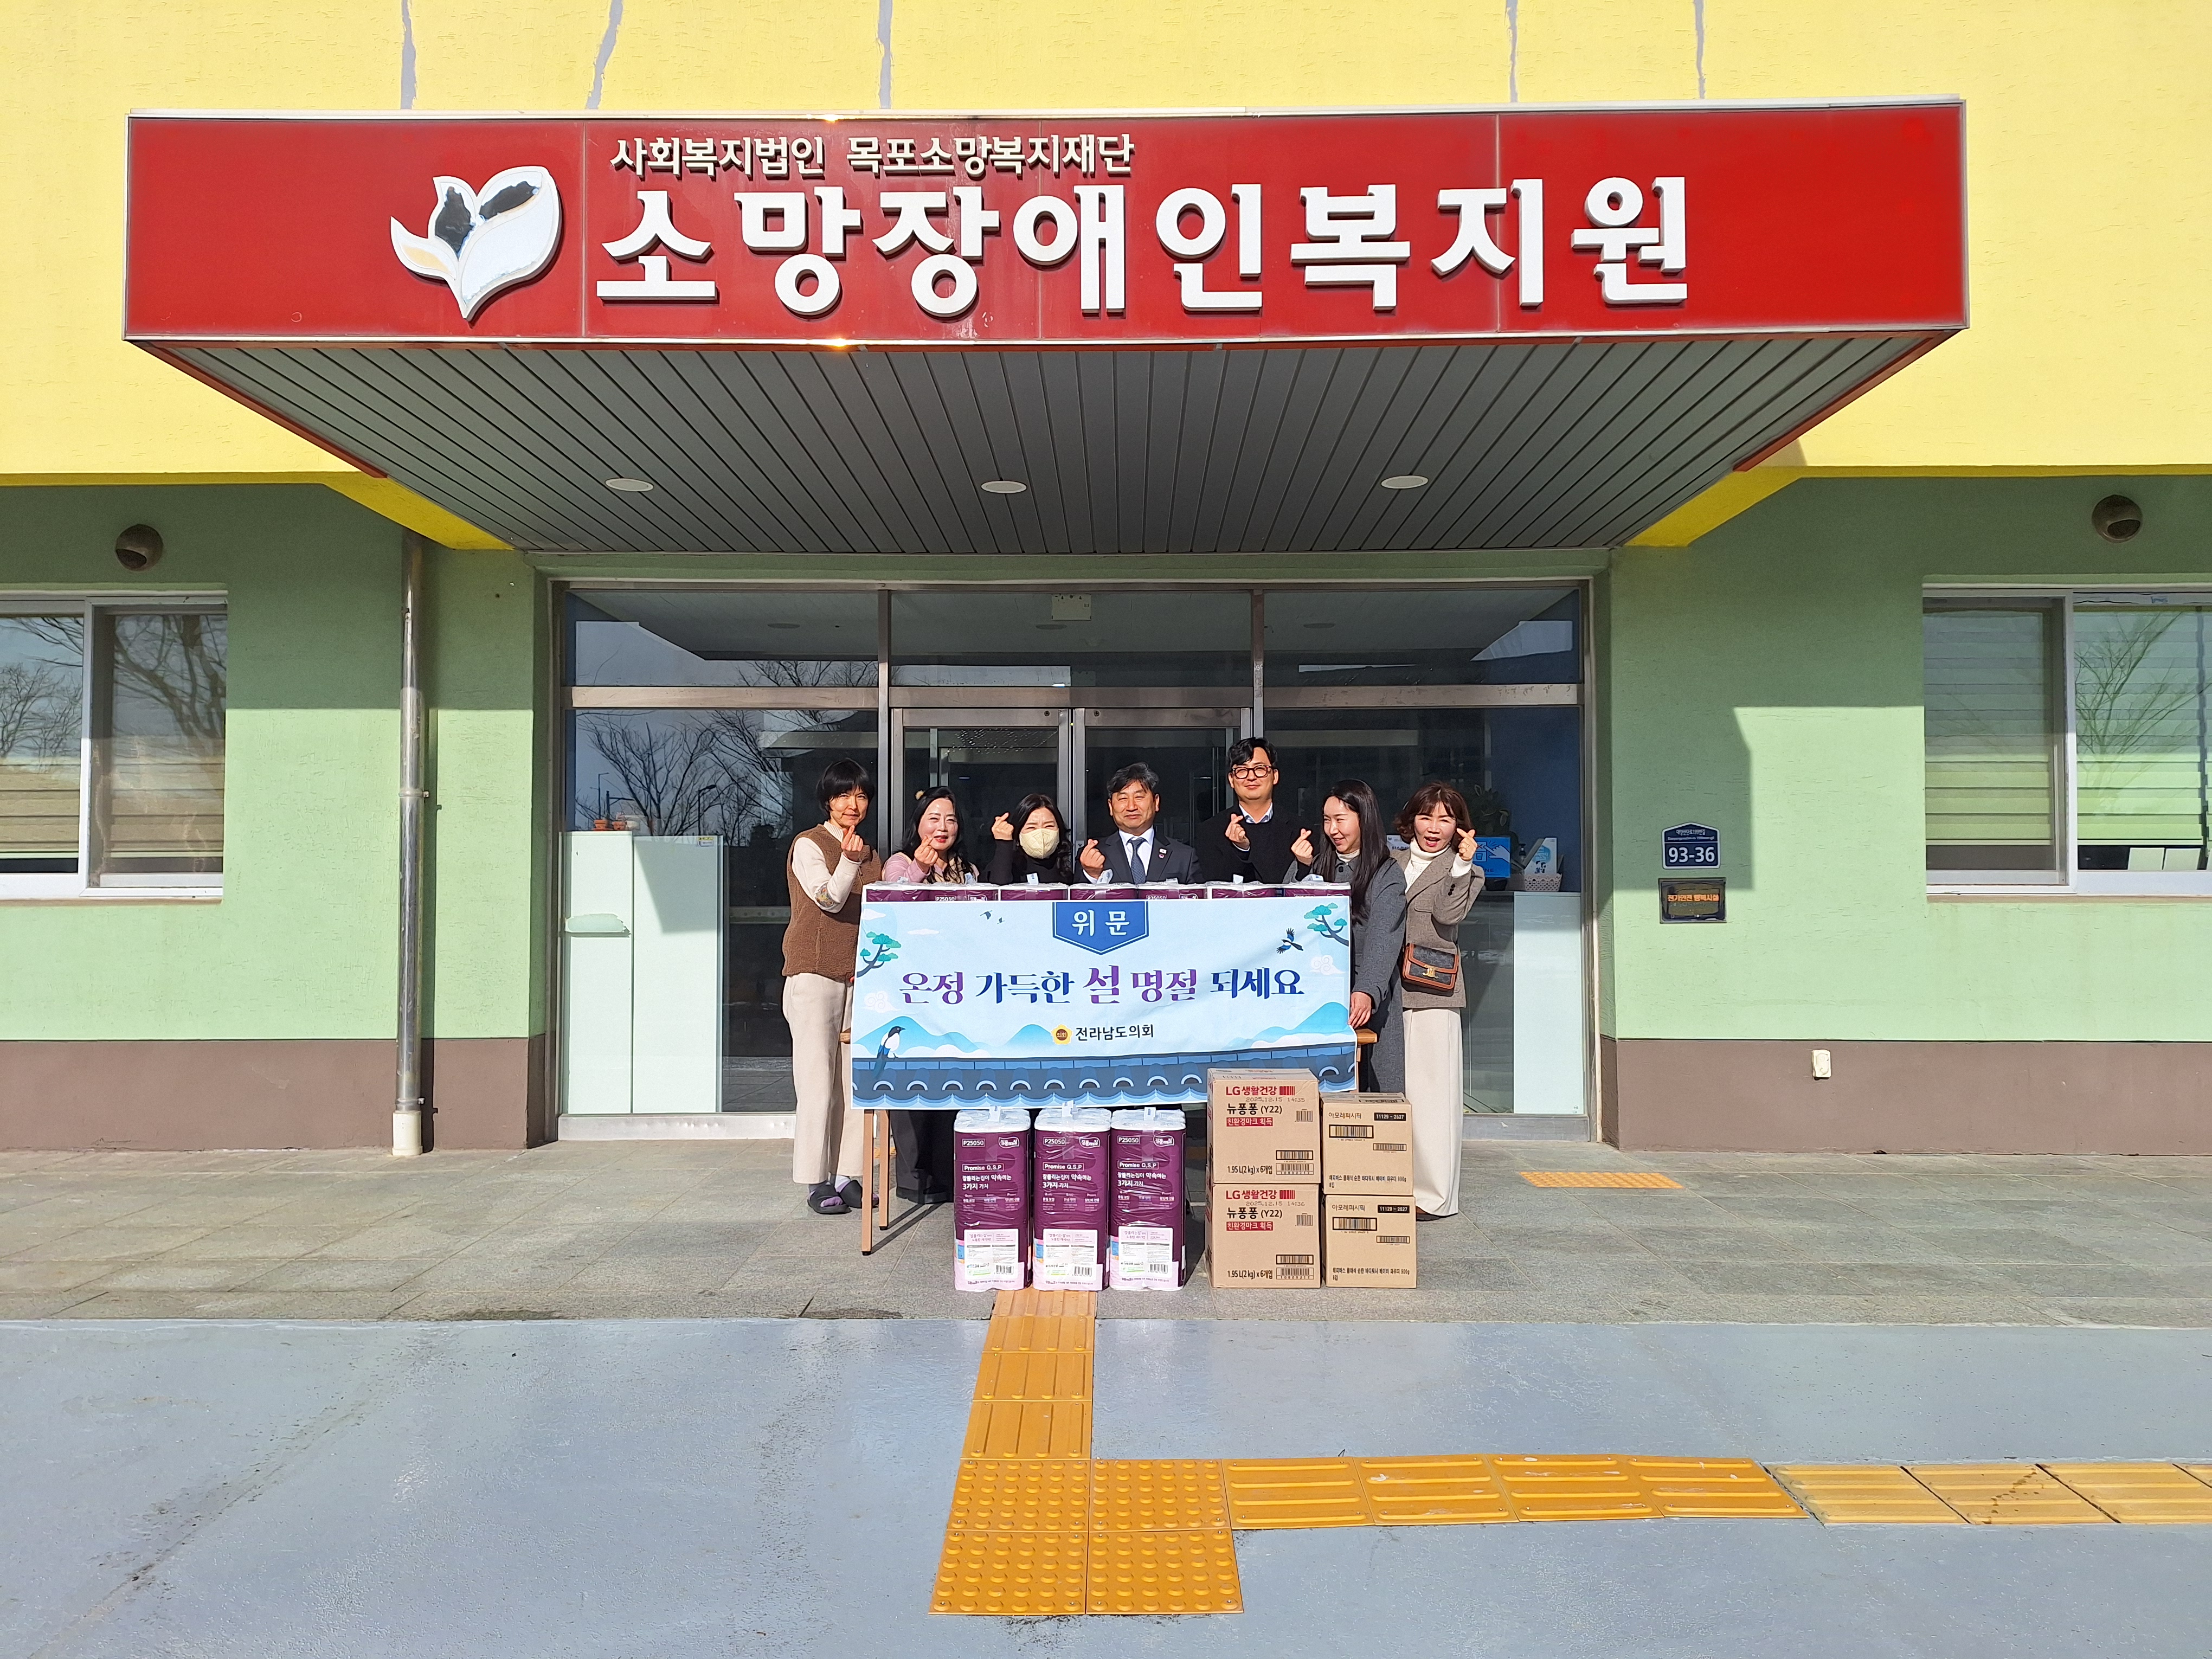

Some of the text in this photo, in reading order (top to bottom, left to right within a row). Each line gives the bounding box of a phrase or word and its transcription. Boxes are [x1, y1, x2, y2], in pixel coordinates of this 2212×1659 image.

[611, 133, 1135, 176] 사회복지법인 목포소망복지재단
[596, 176, 1687, 316] 소망장애인복지원
[1668, 847, 1715, 863] 93-36
[899, 965, 1304, 1004] 온정 가득한 설 명절 되세요
[1076, 1024, 1153, 1041] 전라남도의회
[1227, 1103, 1282, 1115] 뉴퐁퐁 (Y22)
[1227, 1118, 1272, 1126] 친환경마크 획득
[1227, 1207, 1282, 1219] 뉴퐁퐁 (Y22)
[1227, 1222, 1272, 1230] 친환경마크 획득
[1260, 1270, 1272, 1279] 6개입
